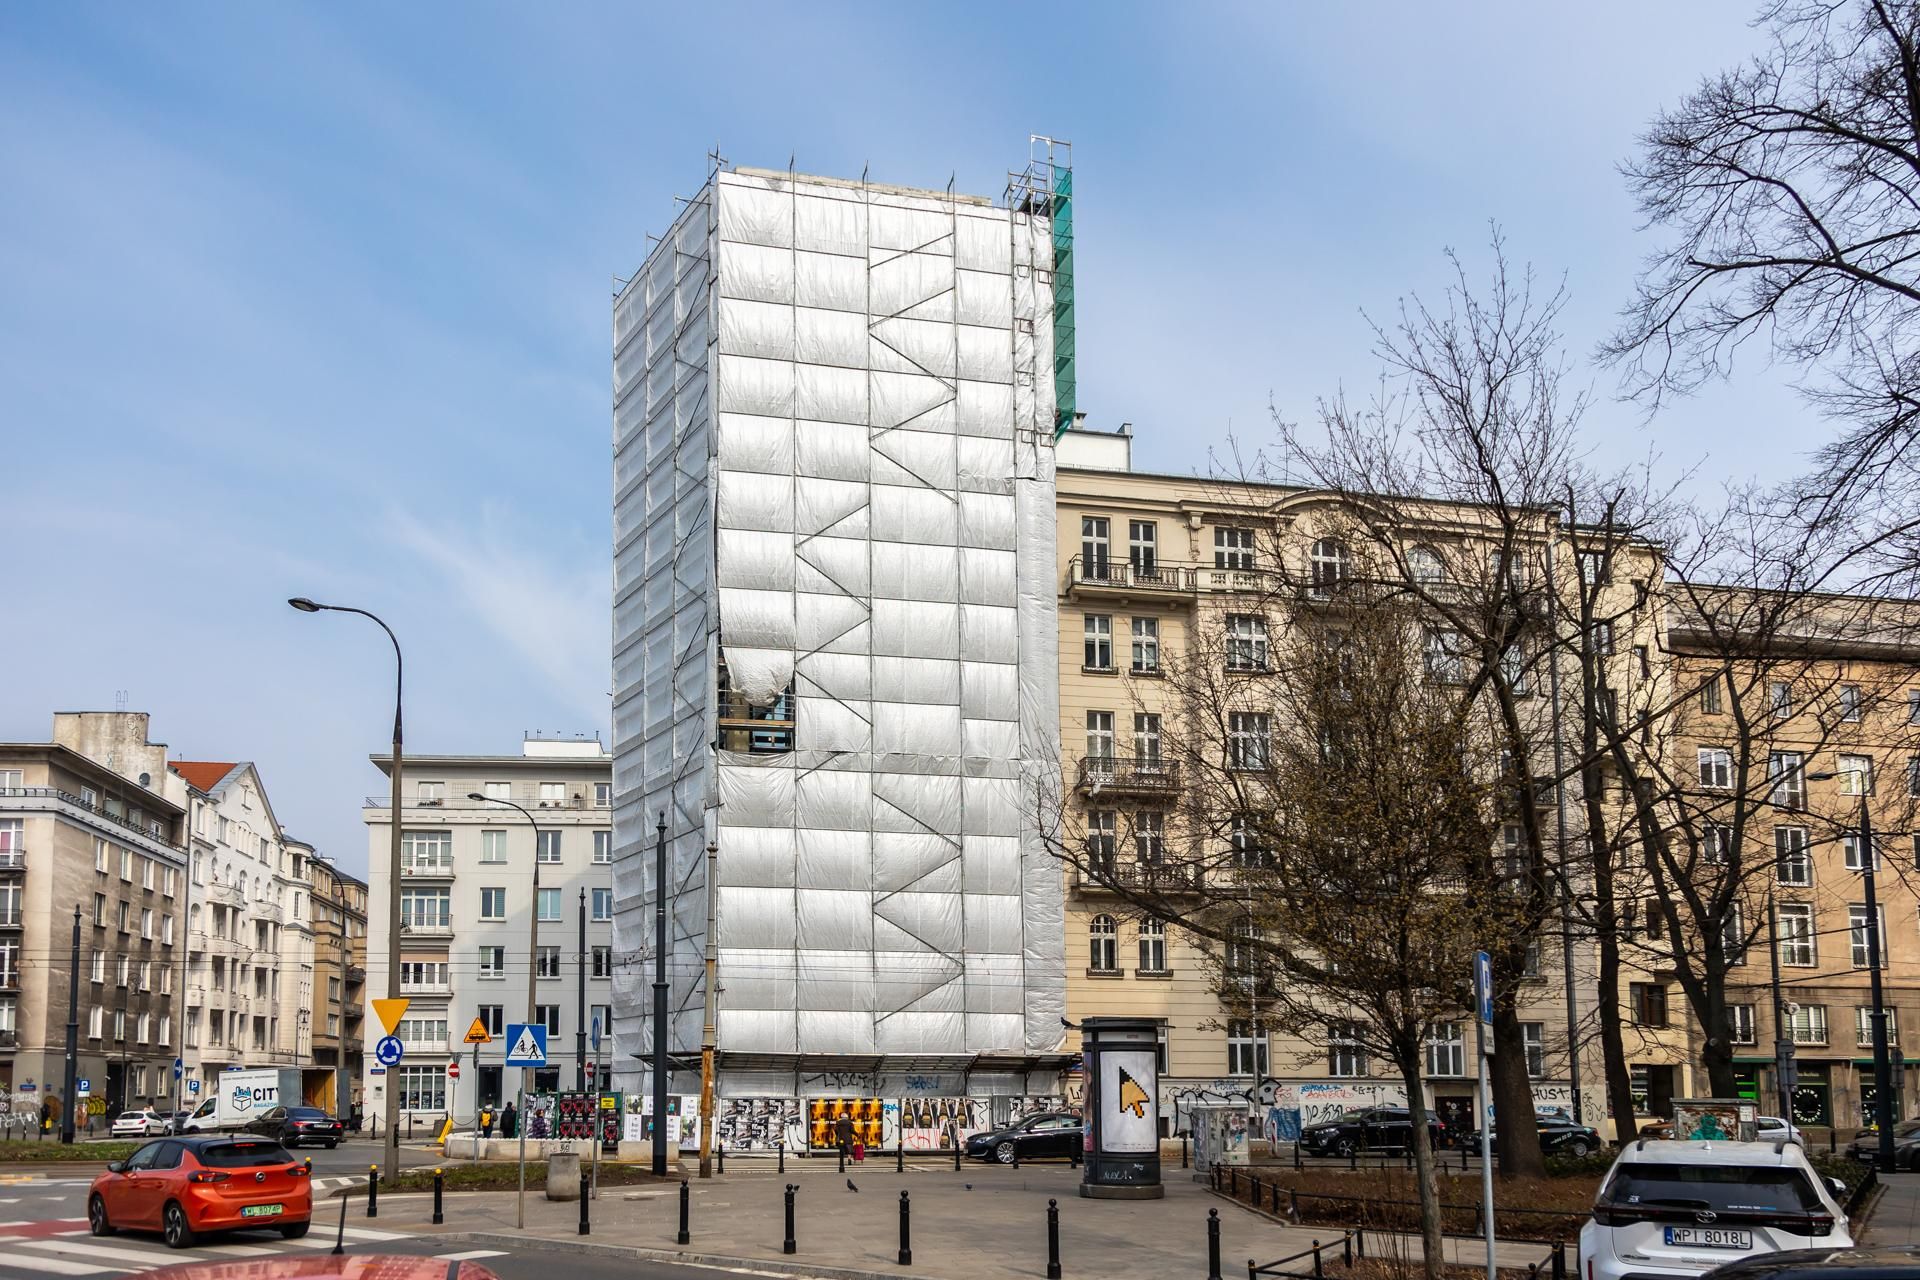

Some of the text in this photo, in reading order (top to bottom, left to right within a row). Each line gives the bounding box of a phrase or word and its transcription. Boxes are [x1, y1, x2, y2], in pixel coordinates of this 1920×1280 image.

[81, 1080, 89, 1090] P
[1673, 1229, 1749, 1245] WPI 8018L
